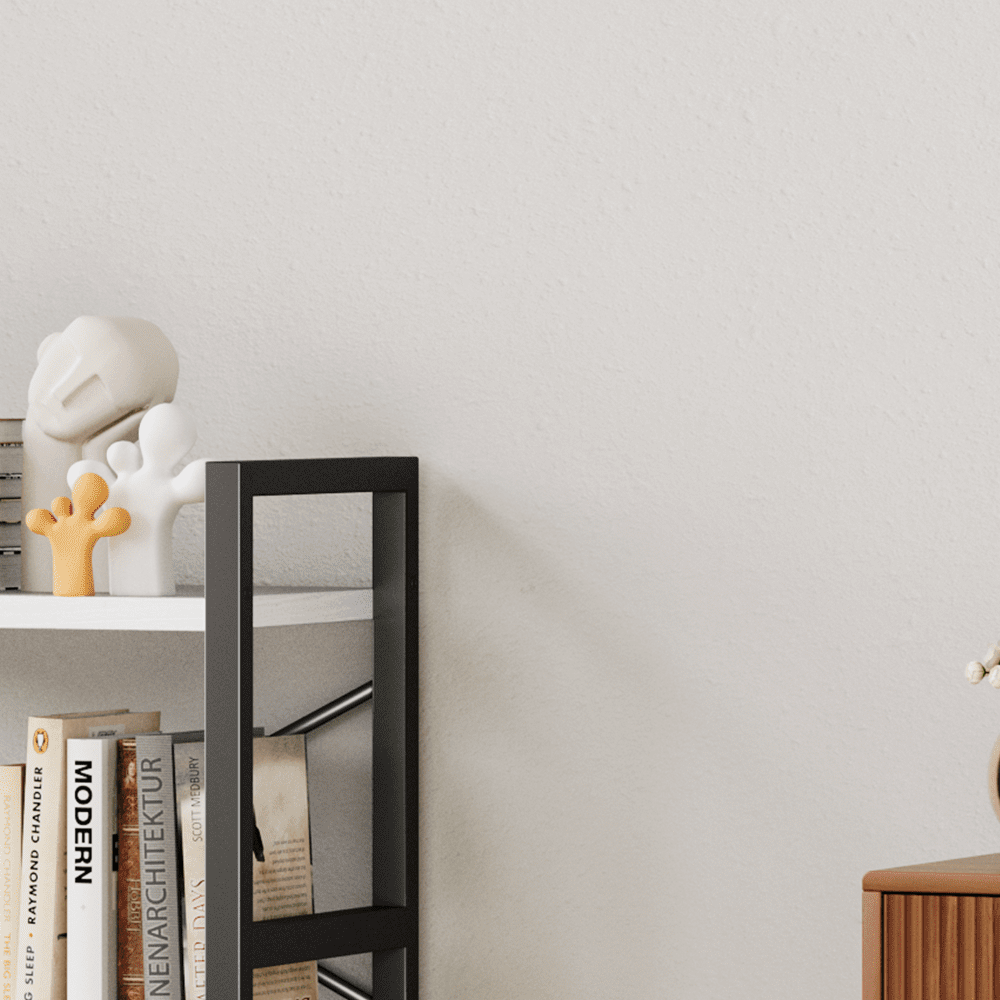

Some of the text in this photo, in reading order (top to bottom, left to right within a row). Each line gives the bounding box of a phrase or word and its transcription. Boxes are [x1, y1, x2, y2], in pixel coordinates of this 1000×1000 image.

[27, 766, 44, 924] RAYMOND CHANDLER
[74, 760, 93, 884] MODERN
[190, 756, 203, 842] SCOTT MEDBURY
[24, 945, 35, 985] SLEEP
